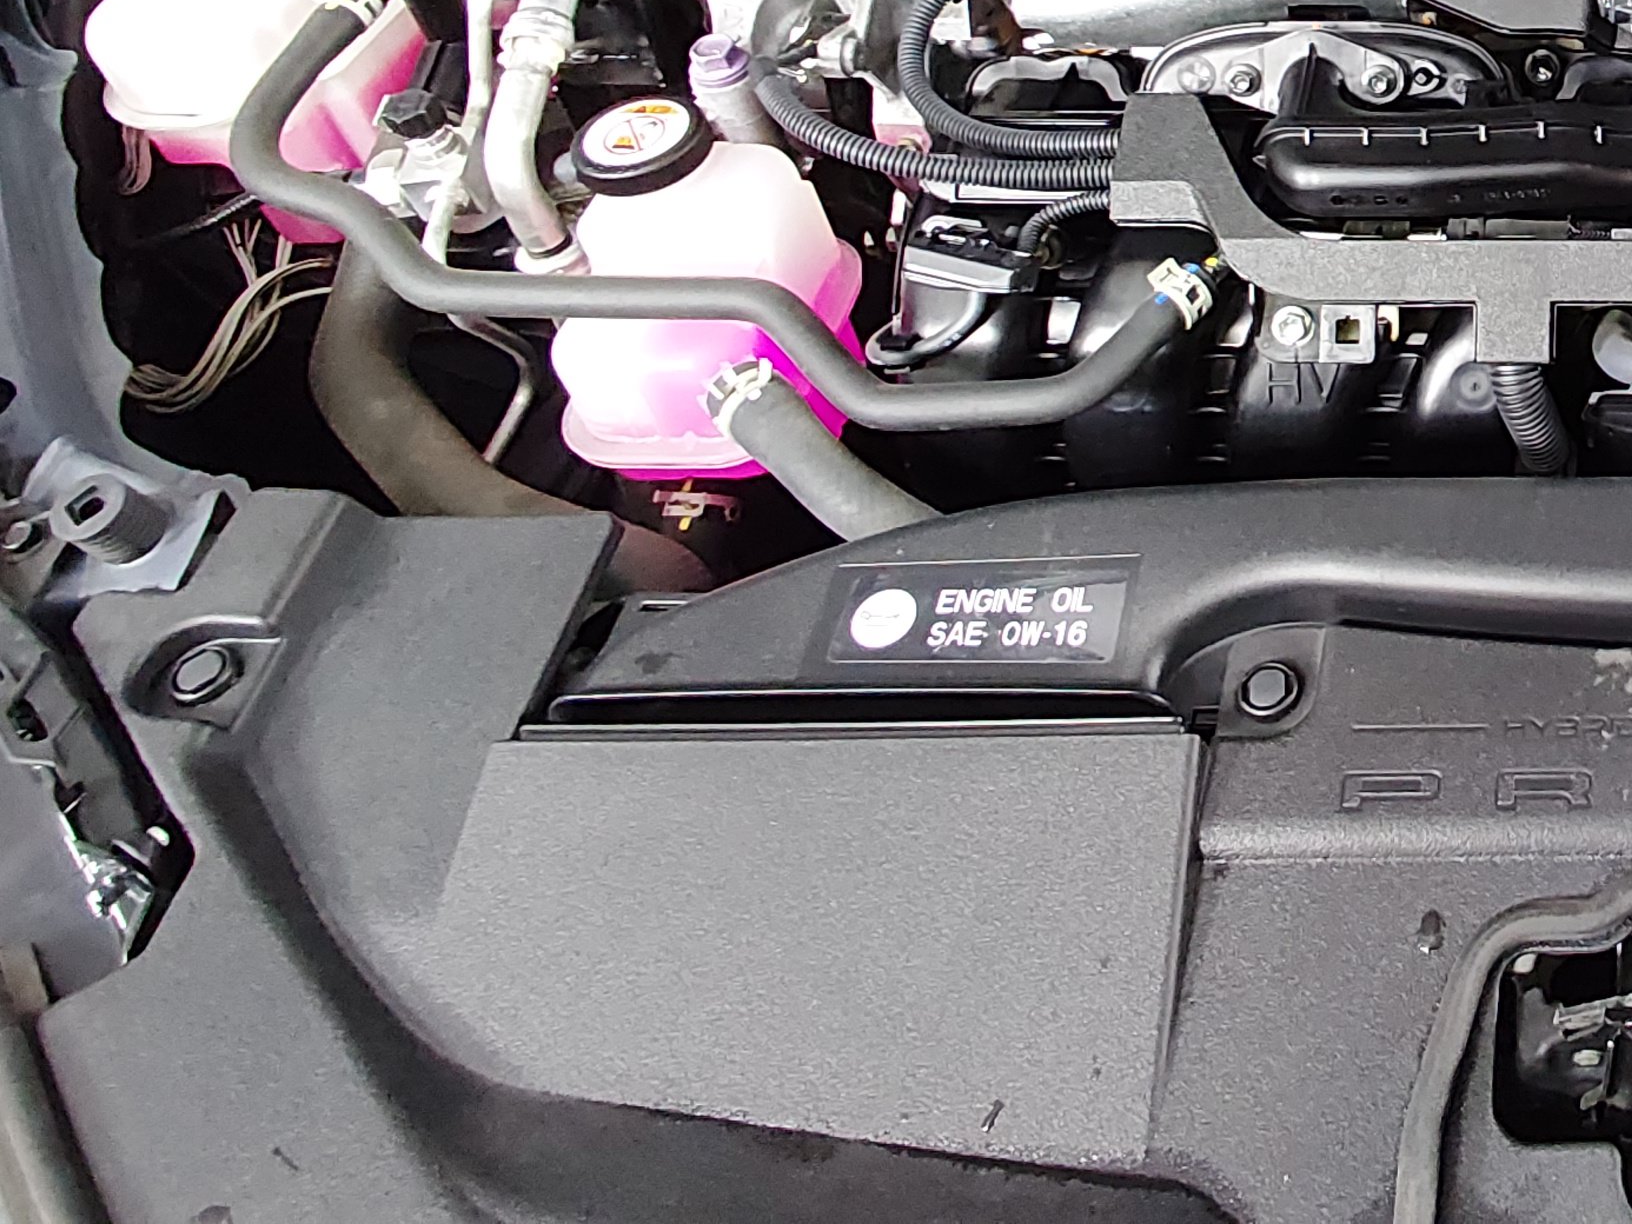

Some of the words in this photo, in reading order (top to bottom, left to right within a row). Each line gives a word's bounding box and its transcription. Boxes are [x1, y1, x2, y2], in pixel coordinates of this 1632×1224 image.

[935, 587, 1037, 615] ENGINE
[1050, 587, 1094, 613] OIL
[926, 620, 984, 647] SAE
[1000, 620, 1089, 647] 0W-16
